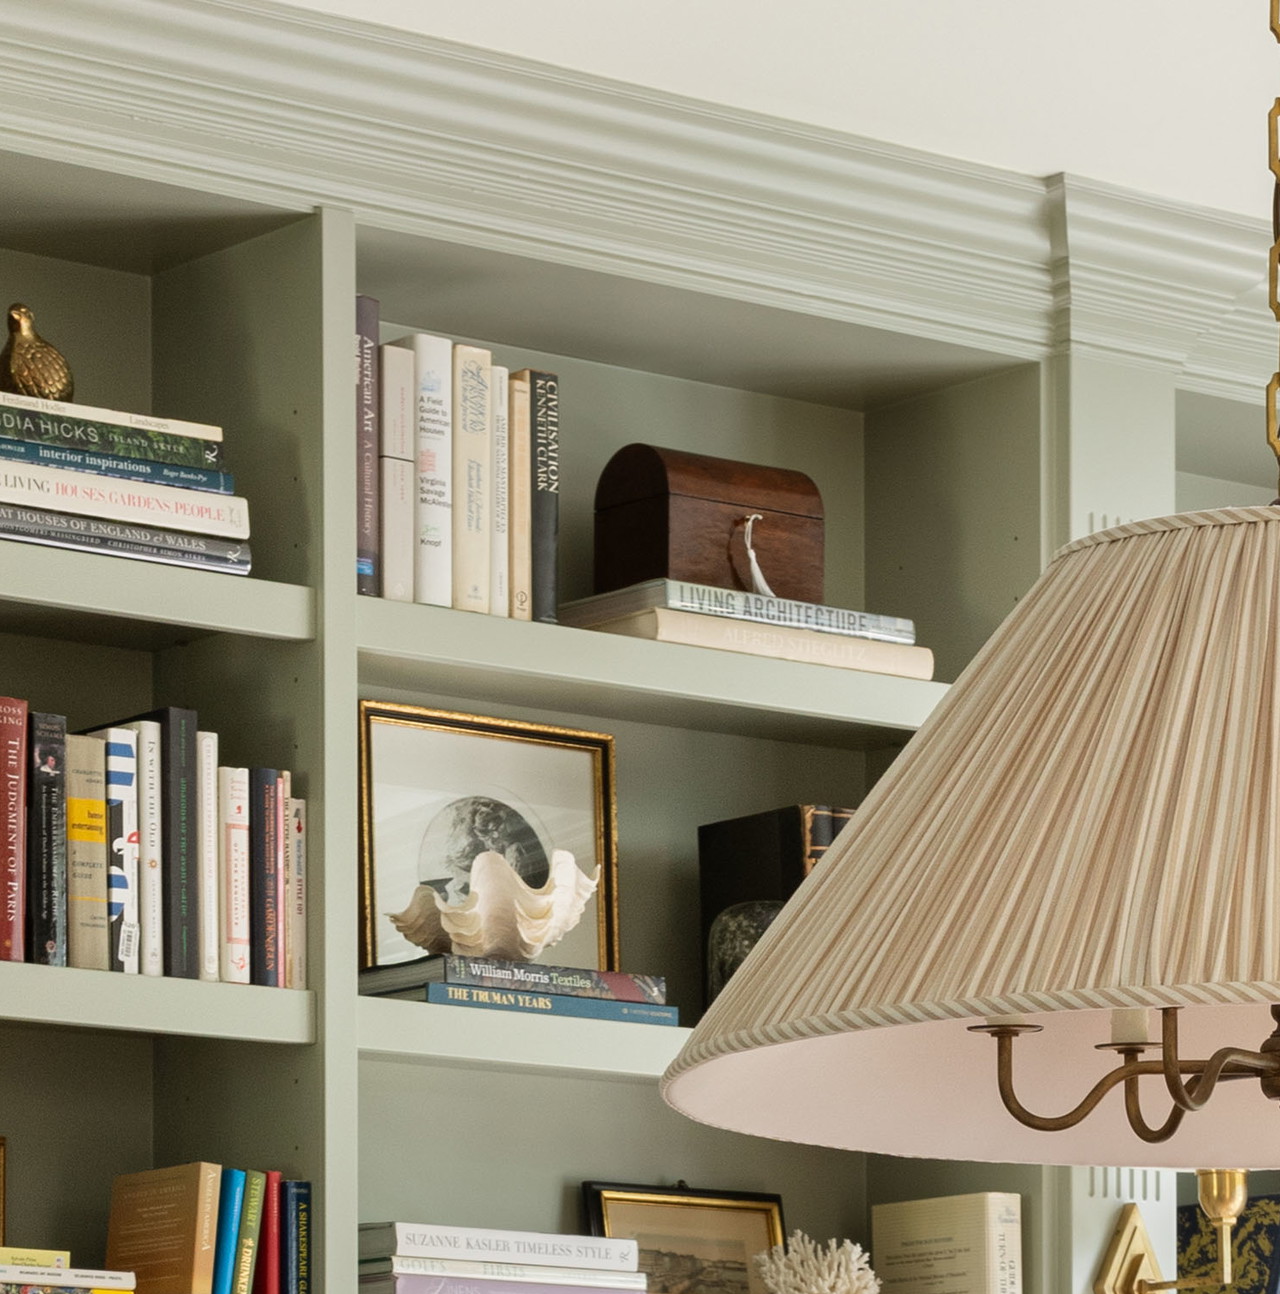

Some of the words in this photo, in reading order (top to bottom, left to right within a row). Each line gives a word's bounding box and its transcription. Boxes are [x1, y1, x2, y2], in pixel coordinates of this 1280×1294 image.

[362, 335, 375, 407] American
[40, 421, 100, 444] HICKS
[363, 409, 375, 432] Art
[535, 380, 549, 445] KENNETH
[364, 440, 373, 449] A
[546, 380, 560, 494] CIVILISATION
[38, 446, 83, 464] interior
[85, 453, 152, 474] inspirations
[364, 451, 374, 496] Cultural
[536, 446, 548, 491] CLARK
[4, 472, 51, 493] LIVING
[174, 501, 226, 522] PEOPLE
[363, 498, 374, 536] History
[16, 510, 67, 528] HOUSES
[70, 518, 88, 531] OF
[90, 520, 151, 542] ENGLAND
[164, 533, 207, 551] WALES
[420, 538, 442, 548] Knopf
[679, 584, 737, 616] LIVING
[742, 598, 867, 637] ARCHITECTURE
[7, 737, 20, 768] THE
[7, 774, 20, 851] JUDGMENT
[7, 855, 17, 875] OF
[6, 878, 19, 922] PARIS
[470, 963, 513, 980] William
[513, 968, 550, 985] Morris
[550, 972, 592, 989] Textiles
[446, 987, 470, 1001] THE
[471, 989, 515, 1006] TRUMAN
[517, 996, 553, 1010] YEARS
[246, 1177, 262, 1227] STEWART
[298, 1211, 308, 1278] SHAKESPEARE
[404, 1232, 461, 1249] SUZANNE
[466, 1237, 511, 1253] KASLER
[514, 1240, 573, 1257] TIMELESS
[575, 1246, 613, 1261] STYLE
